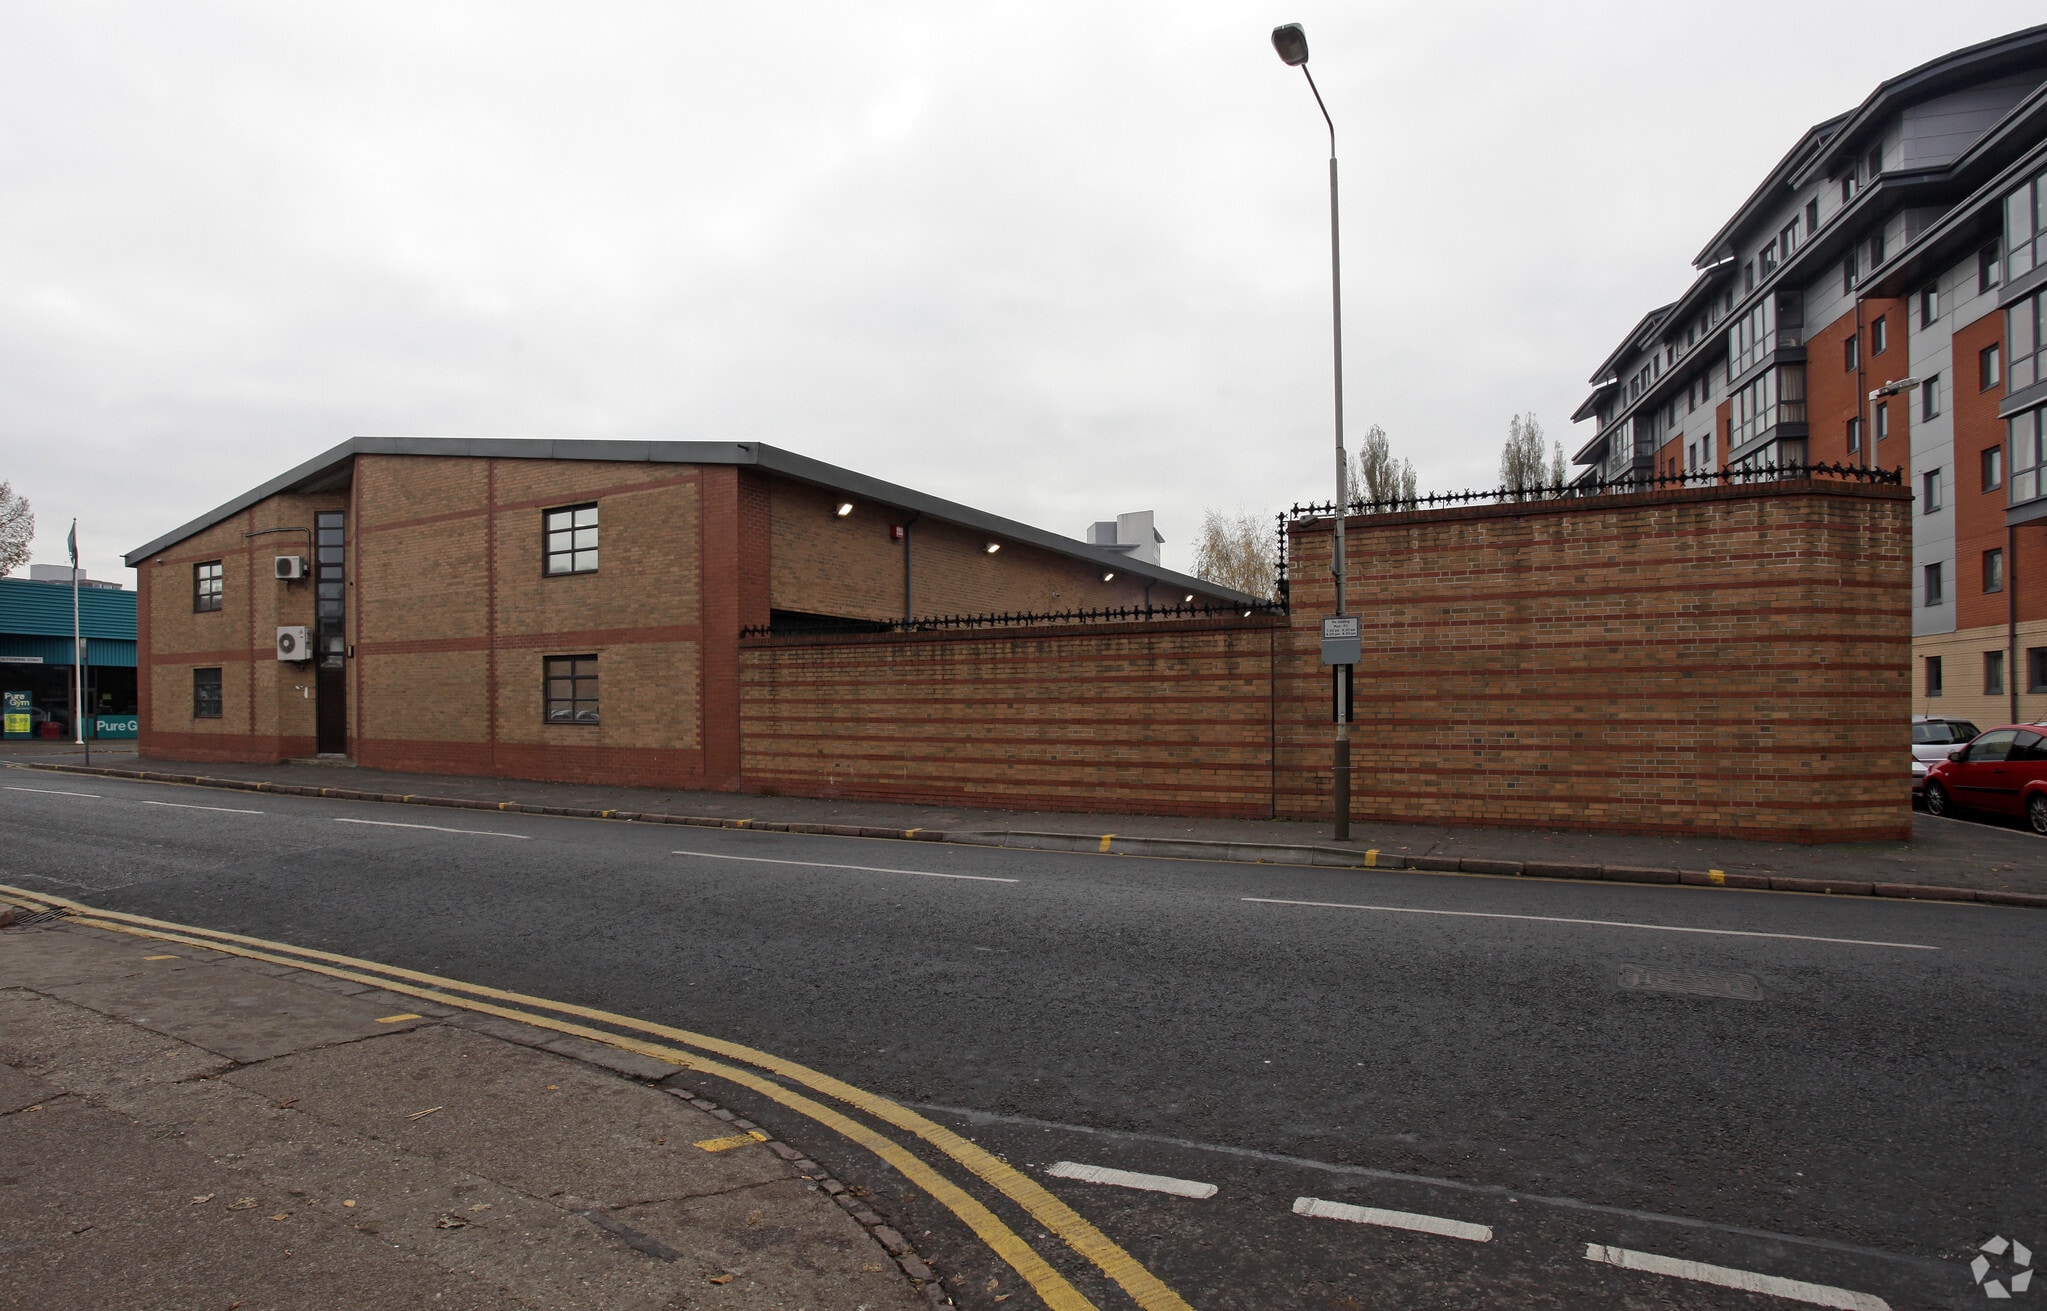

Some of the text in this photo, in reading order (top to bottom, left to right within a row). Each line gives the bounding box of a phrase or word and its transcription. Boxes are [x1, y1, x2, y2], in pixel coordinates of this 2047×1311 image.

[4, 692, 25, 700] Pure
[9, 699, 30, 708] Gym
[96, 720, 126, 731] Pure
